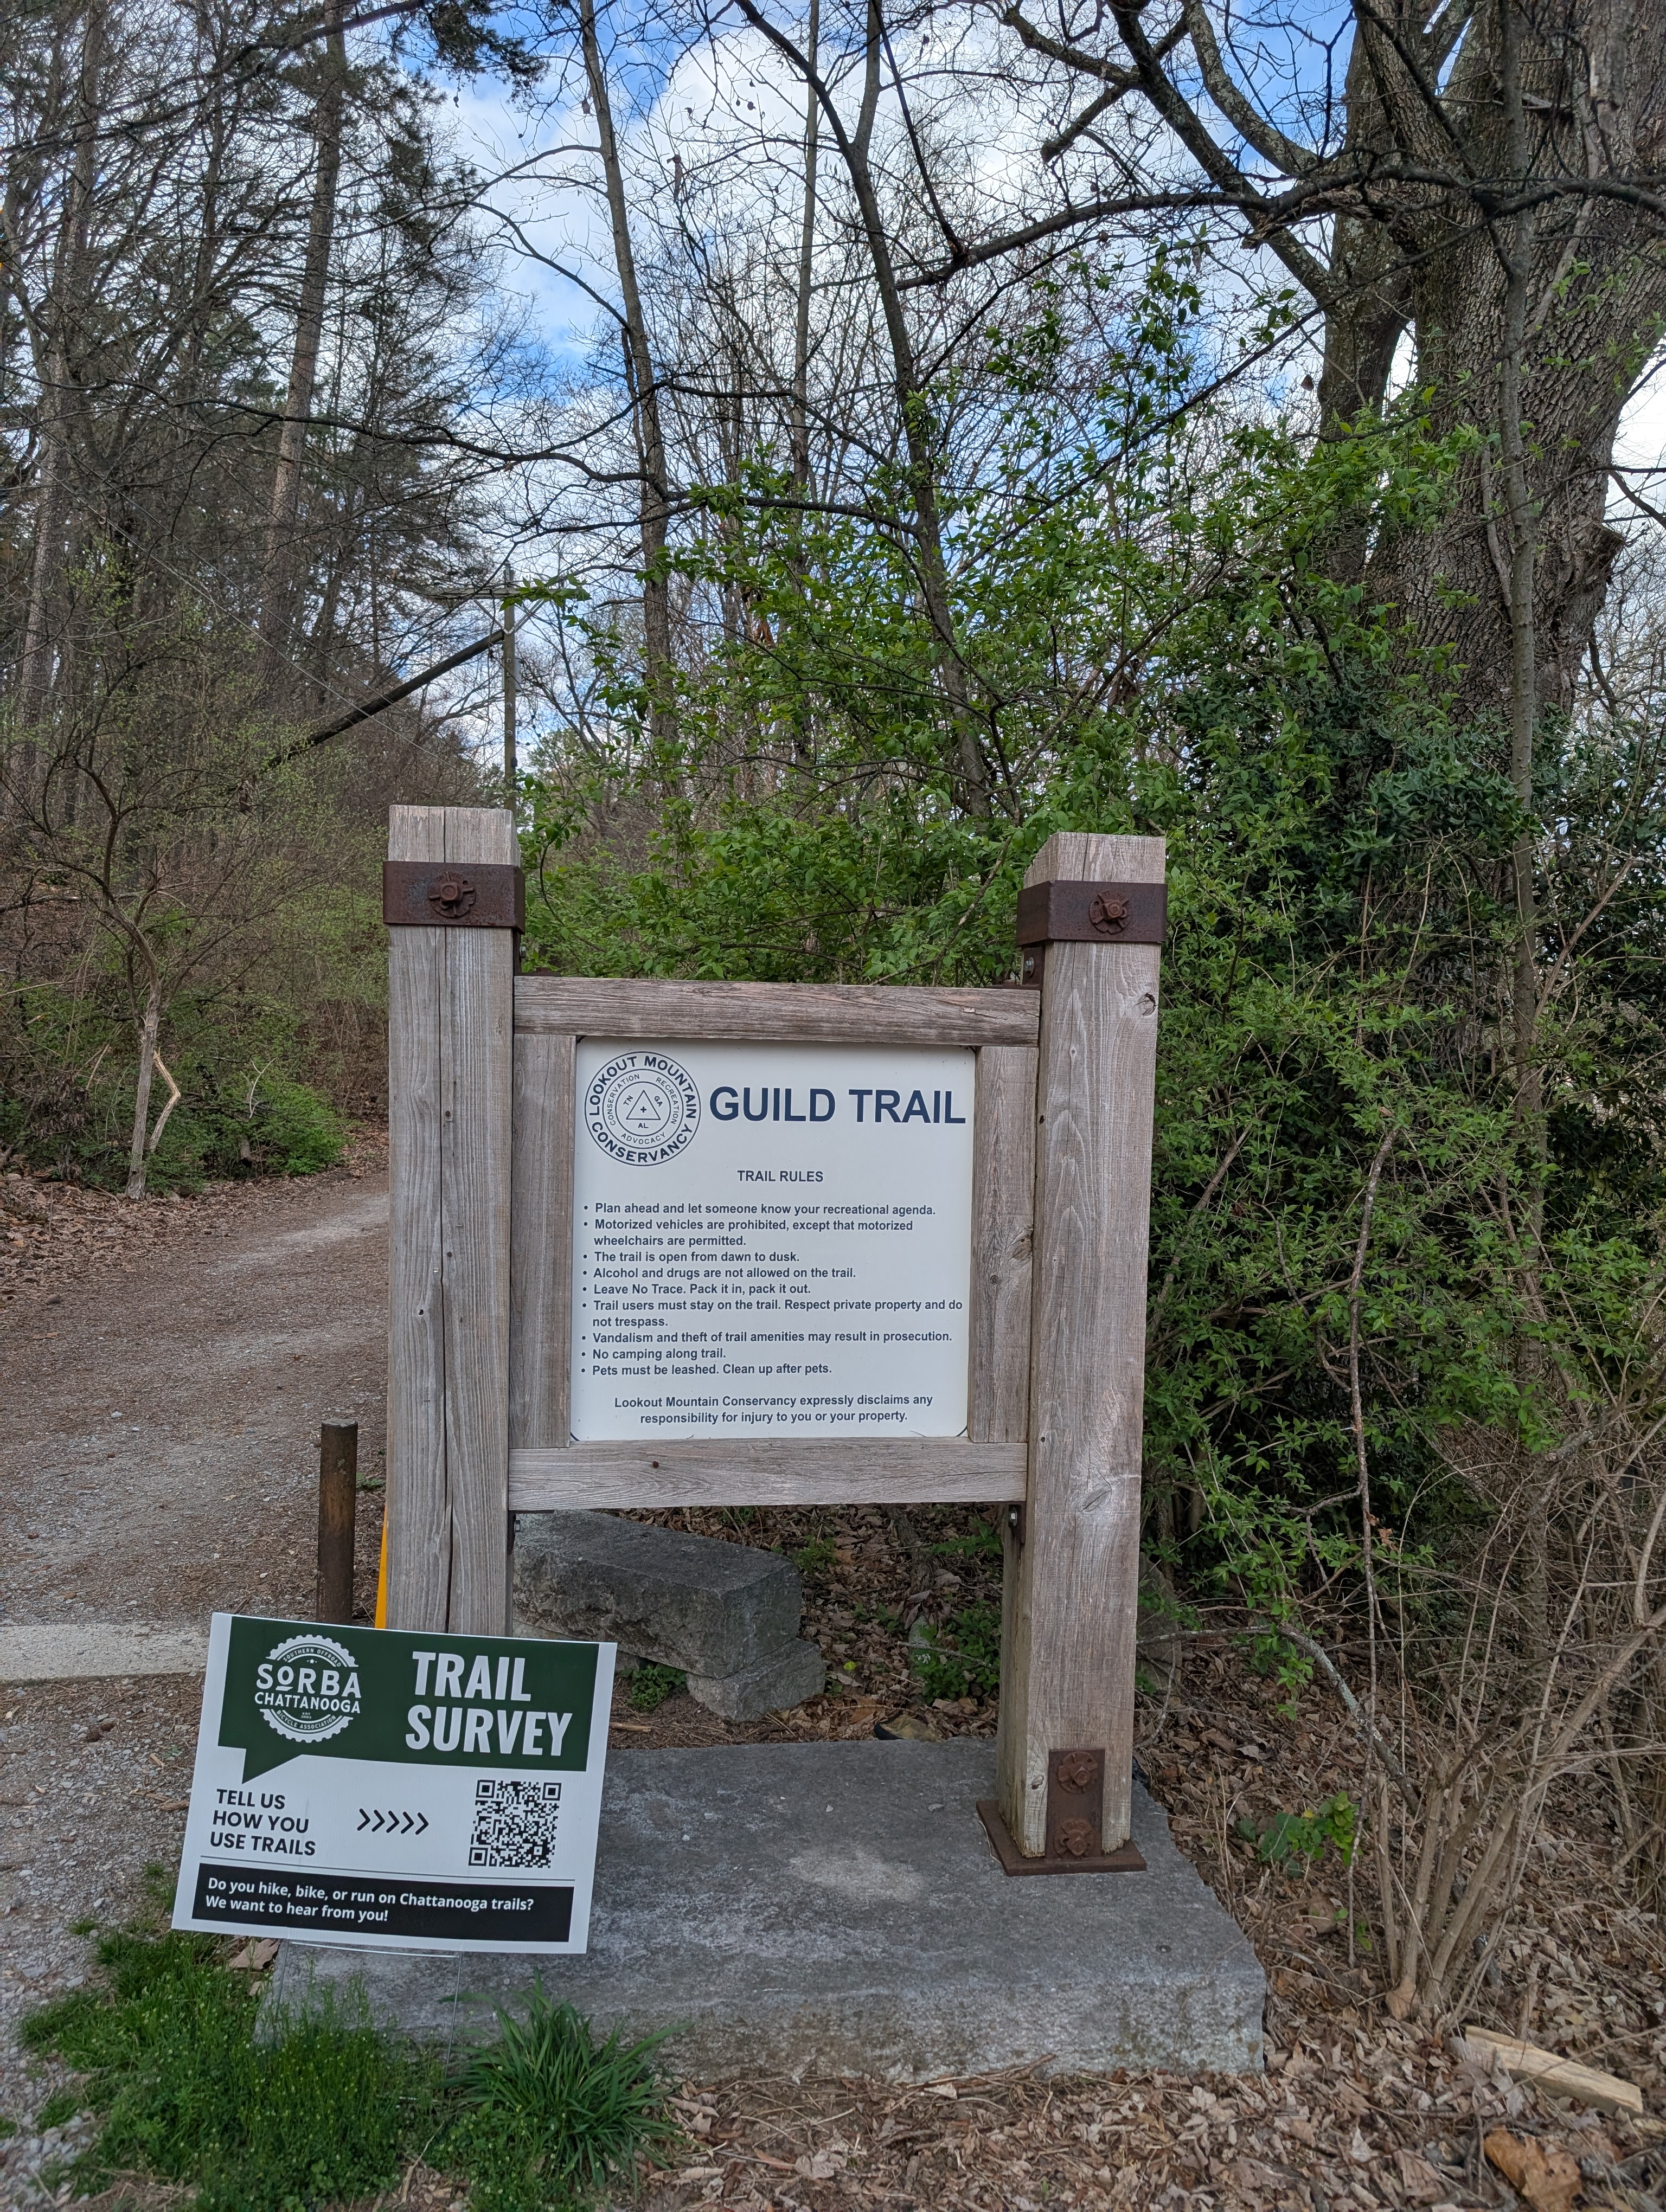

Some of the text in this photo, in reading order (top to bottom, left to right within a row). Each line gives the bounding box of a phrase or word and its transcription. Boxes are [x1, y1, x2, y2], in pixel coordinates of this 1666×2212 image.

[589, 1056, 696, 1118] LOOKOUT MOUNTAIN
[607, 1073, 639, 1126] CONSERVATION
[623, 1095, 633, 1105] TN
[654, 1096, 663, 1107] GA
[656, 1077, 679, 1124] RECREATION
[710, 1086, 965, 1123] GUILD TRAIL
[592, 1122, 692, 1162] CONSERVANCY
[621, 1132, 665, 1144] ADVOCACY
[738, 1171, 823, 1182] TRAIL RULES
[596, 1203, 620, 1212] Plan
[625, 1203, 659, 1213] ahead
[663, 1203, 685, 1213] and
[689, 1203, 702, 1213] let
[761, 1204, 791, 1213] know
[794, 1206, 820, 1216] your
[824, 1204, 888, 1214] recreational
[893, 1205, 935, 1217] agenda.
[595, 1219, 652, 1229] Motorized
[656, 1219, 703, 1229] vehicles
[729, 1220, 789, 1232] prohibited,
[793, 1220, 830, 1232] except
[833, 1220, 854, 1230] that
[858, 1220, 913, 1230] motorized
[594, 1236, 663, 1245] wheelchairs
[689, 1236, 746, 1248] permitted.
[594, 1252, 799, 1264] The trail is open from dawn to dusk.
[593, 1268, 638, 1277] Alcohol
[642, 1268, 663, 1277] and
[667, 1268, 700, 1280] drugs
[726, 1268, 743, 1277] not
[747, 1268, 789, 1278] allowed
[811, 1268, 828, 1277] the
[832, 1268, 855, 1277] trail.
[594, 1284, 810, 1296] Leave No Trace. Pack it in, pack it out.
[594, 1300, 618, 1310] Trail
[658, 1301, 687, 1310] must
[690, 1301, 714, 1312] stay
[735, 1300, 752, 1309] the
[757, 1300, 780, 1309] trail.
[785, 1300, 830, 1311] Respect
[834, 1300, 871, 1311] private
[875, 1300, 921, 1311] property
[925, 1300, 945, 1309] and
[949, 1300, 962, 1309] do
[593, 1317, 668, 1328] not trespass.
[593, 1331, 951, 1343] Vandalism and theft of trail amenities may result in prosecution.
[593, 1348, 726, 1361] No camping along trail.
[593, 1364, 831, 1375] Pets must be leashed. Clean up after pets.
[615, 1394, 933, 1407] Lookout Mountain Conservancy expressly disclaims any
[641, 1412, 718, 1425] responsibility
[722, 1412, 738, 1422] for
[742, 1412, 773, 1424] injury
[777, 1412, 787, 1421] to
[791, 1414, 811, 1424] you
[830, 1413, 855, 1423] your
[859, 1411, 907, 1423] property.
[283, 1648, 341, 1667] SOUTHERN OFFROAD
[256, 1663, 361, 1698] SORBA
[413, 1651, 531, 1701] TRAIL
[254, 1692, 360, 1713] CHATTANOOGA
[277, 1710, 336, 1729] BICYCLE ASSOCIATION
[406, 1705, 572, 1756] SURVEY
[217, 1789, 285, 1809] TELL US
[213, 1810, 309, 1833] HOW YOU
[210, 1832, 315, 1855] USE TRAILS
[208, 1877, 534, 1912] Do you hike, bike, or run on Chattanooga trails?
[206, 1895, 388, 1922] We want to hear from you!
